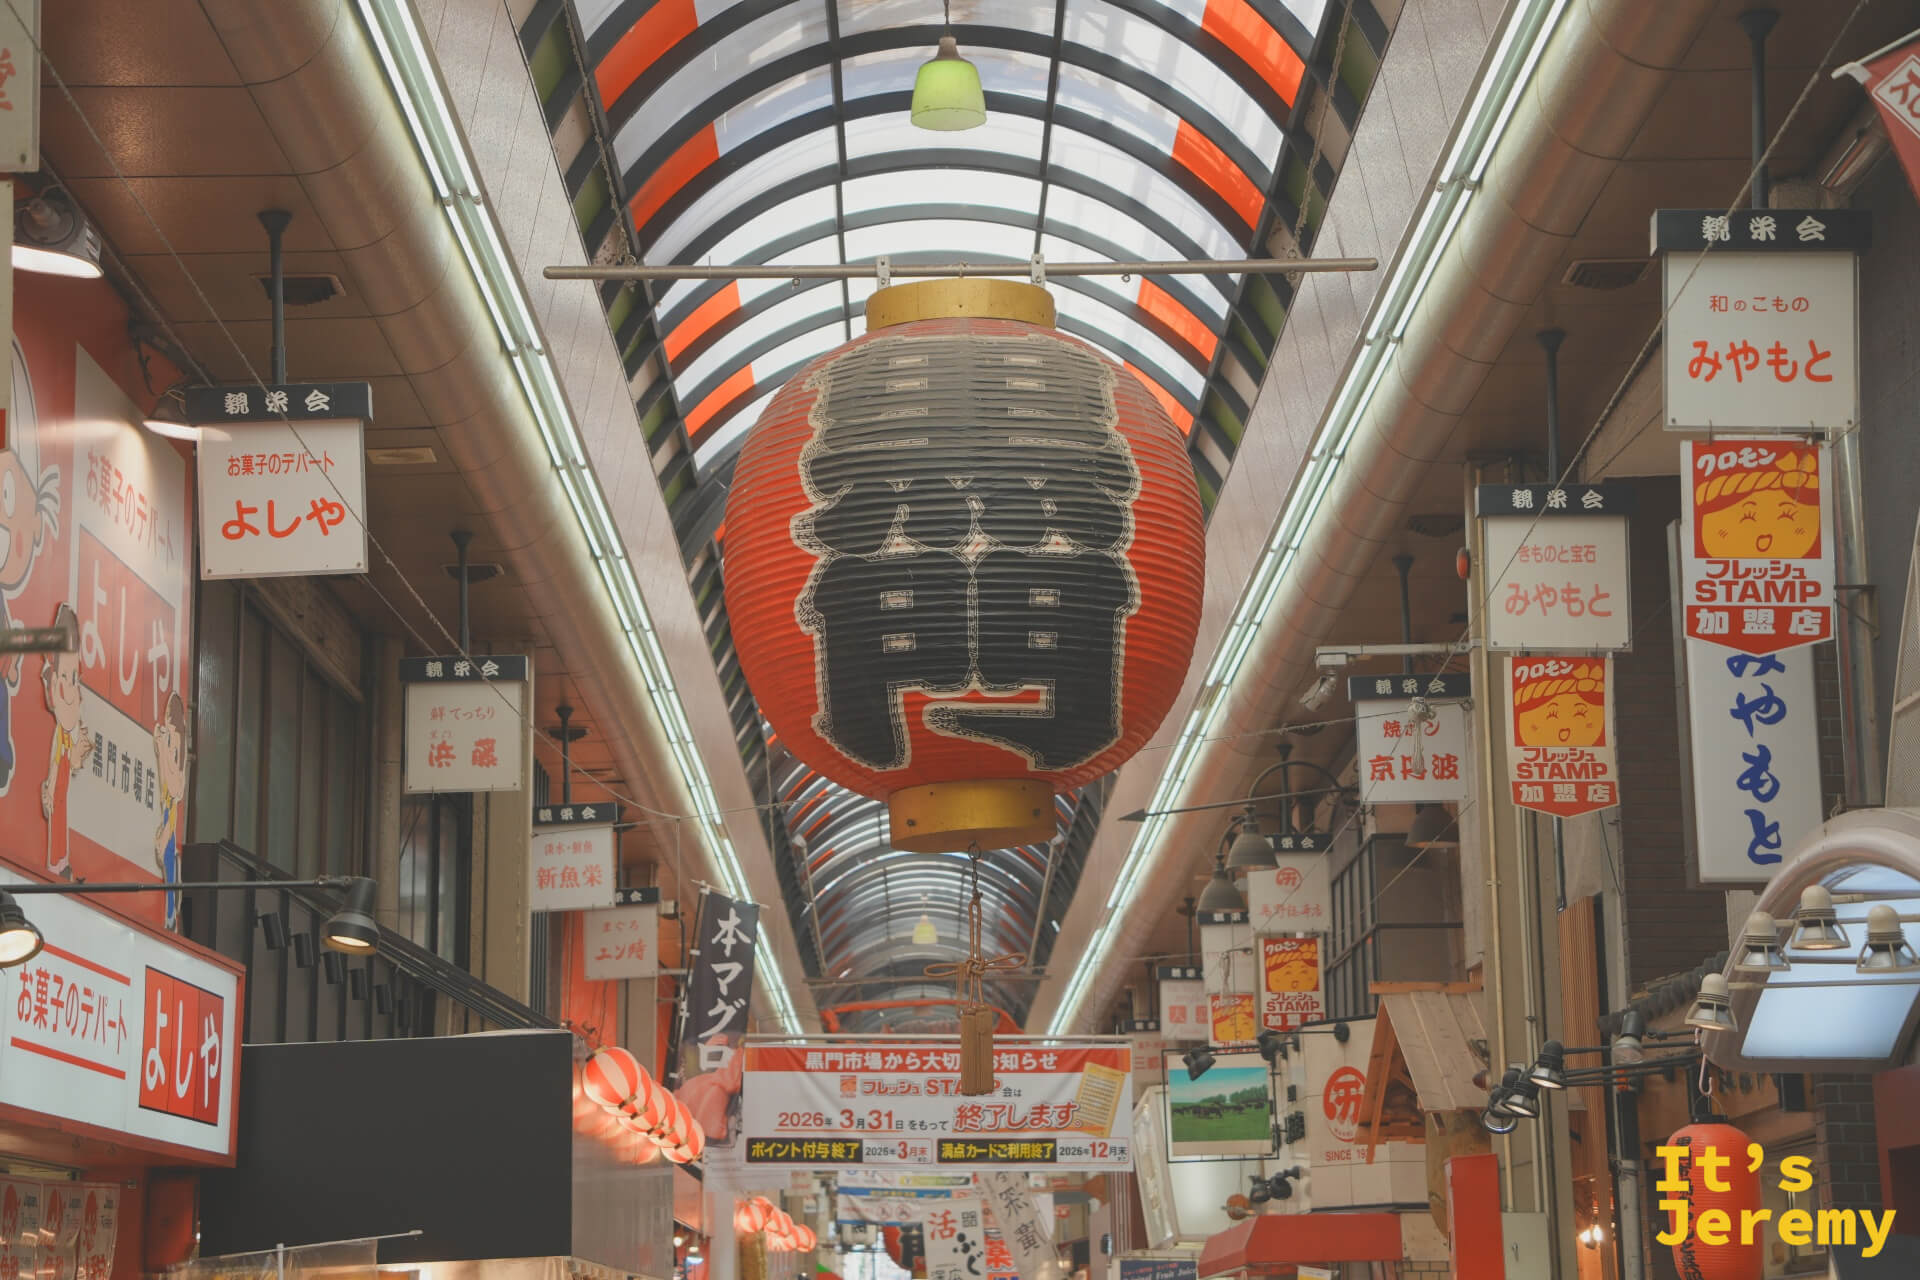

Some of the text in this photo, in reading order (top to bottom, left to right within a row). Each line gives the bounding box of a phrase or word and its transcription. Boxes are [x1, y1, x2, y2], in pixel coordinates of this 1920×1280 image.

[1709, 294, 1809, 314] 和のこもの
[1687, 339, 1834, 383] みやもと
[1697, 446, 1777, 477] クロモン
[220, 497, 345, 541] よしや
[1518, 545, 1597, 565] きものと宝石
[1705, 559, 1807, 581] フレッシュ
[1504, 581, 1613, 619] みやもと
[1695, 580, 1822, 604] STAMP
[1696, 608, 1823, 636] 加盟店
[80, 558, 174, 721] よしや
[1514, 660, 1575, 683] クロモン
[1522, 747, 1596, 763] フレッシュ
[1516, 763, 1608, 780] STAMP
[1519, 784, 1612, 804] 加盟店
[537, 863, 604, 890] 新魚栄
[698, 906, 752, 1072] 本マグロ
[17, 963, 128, 1056] お菓子のデパート
[1266, 1001, 1320, 1012] STAMP
[145, 987, 220, 1109] よしや
[805, 1051, 1059, 1071] 黒門市場から大切知らせ
[1324, 1149, 1352, 1162] SINCE
